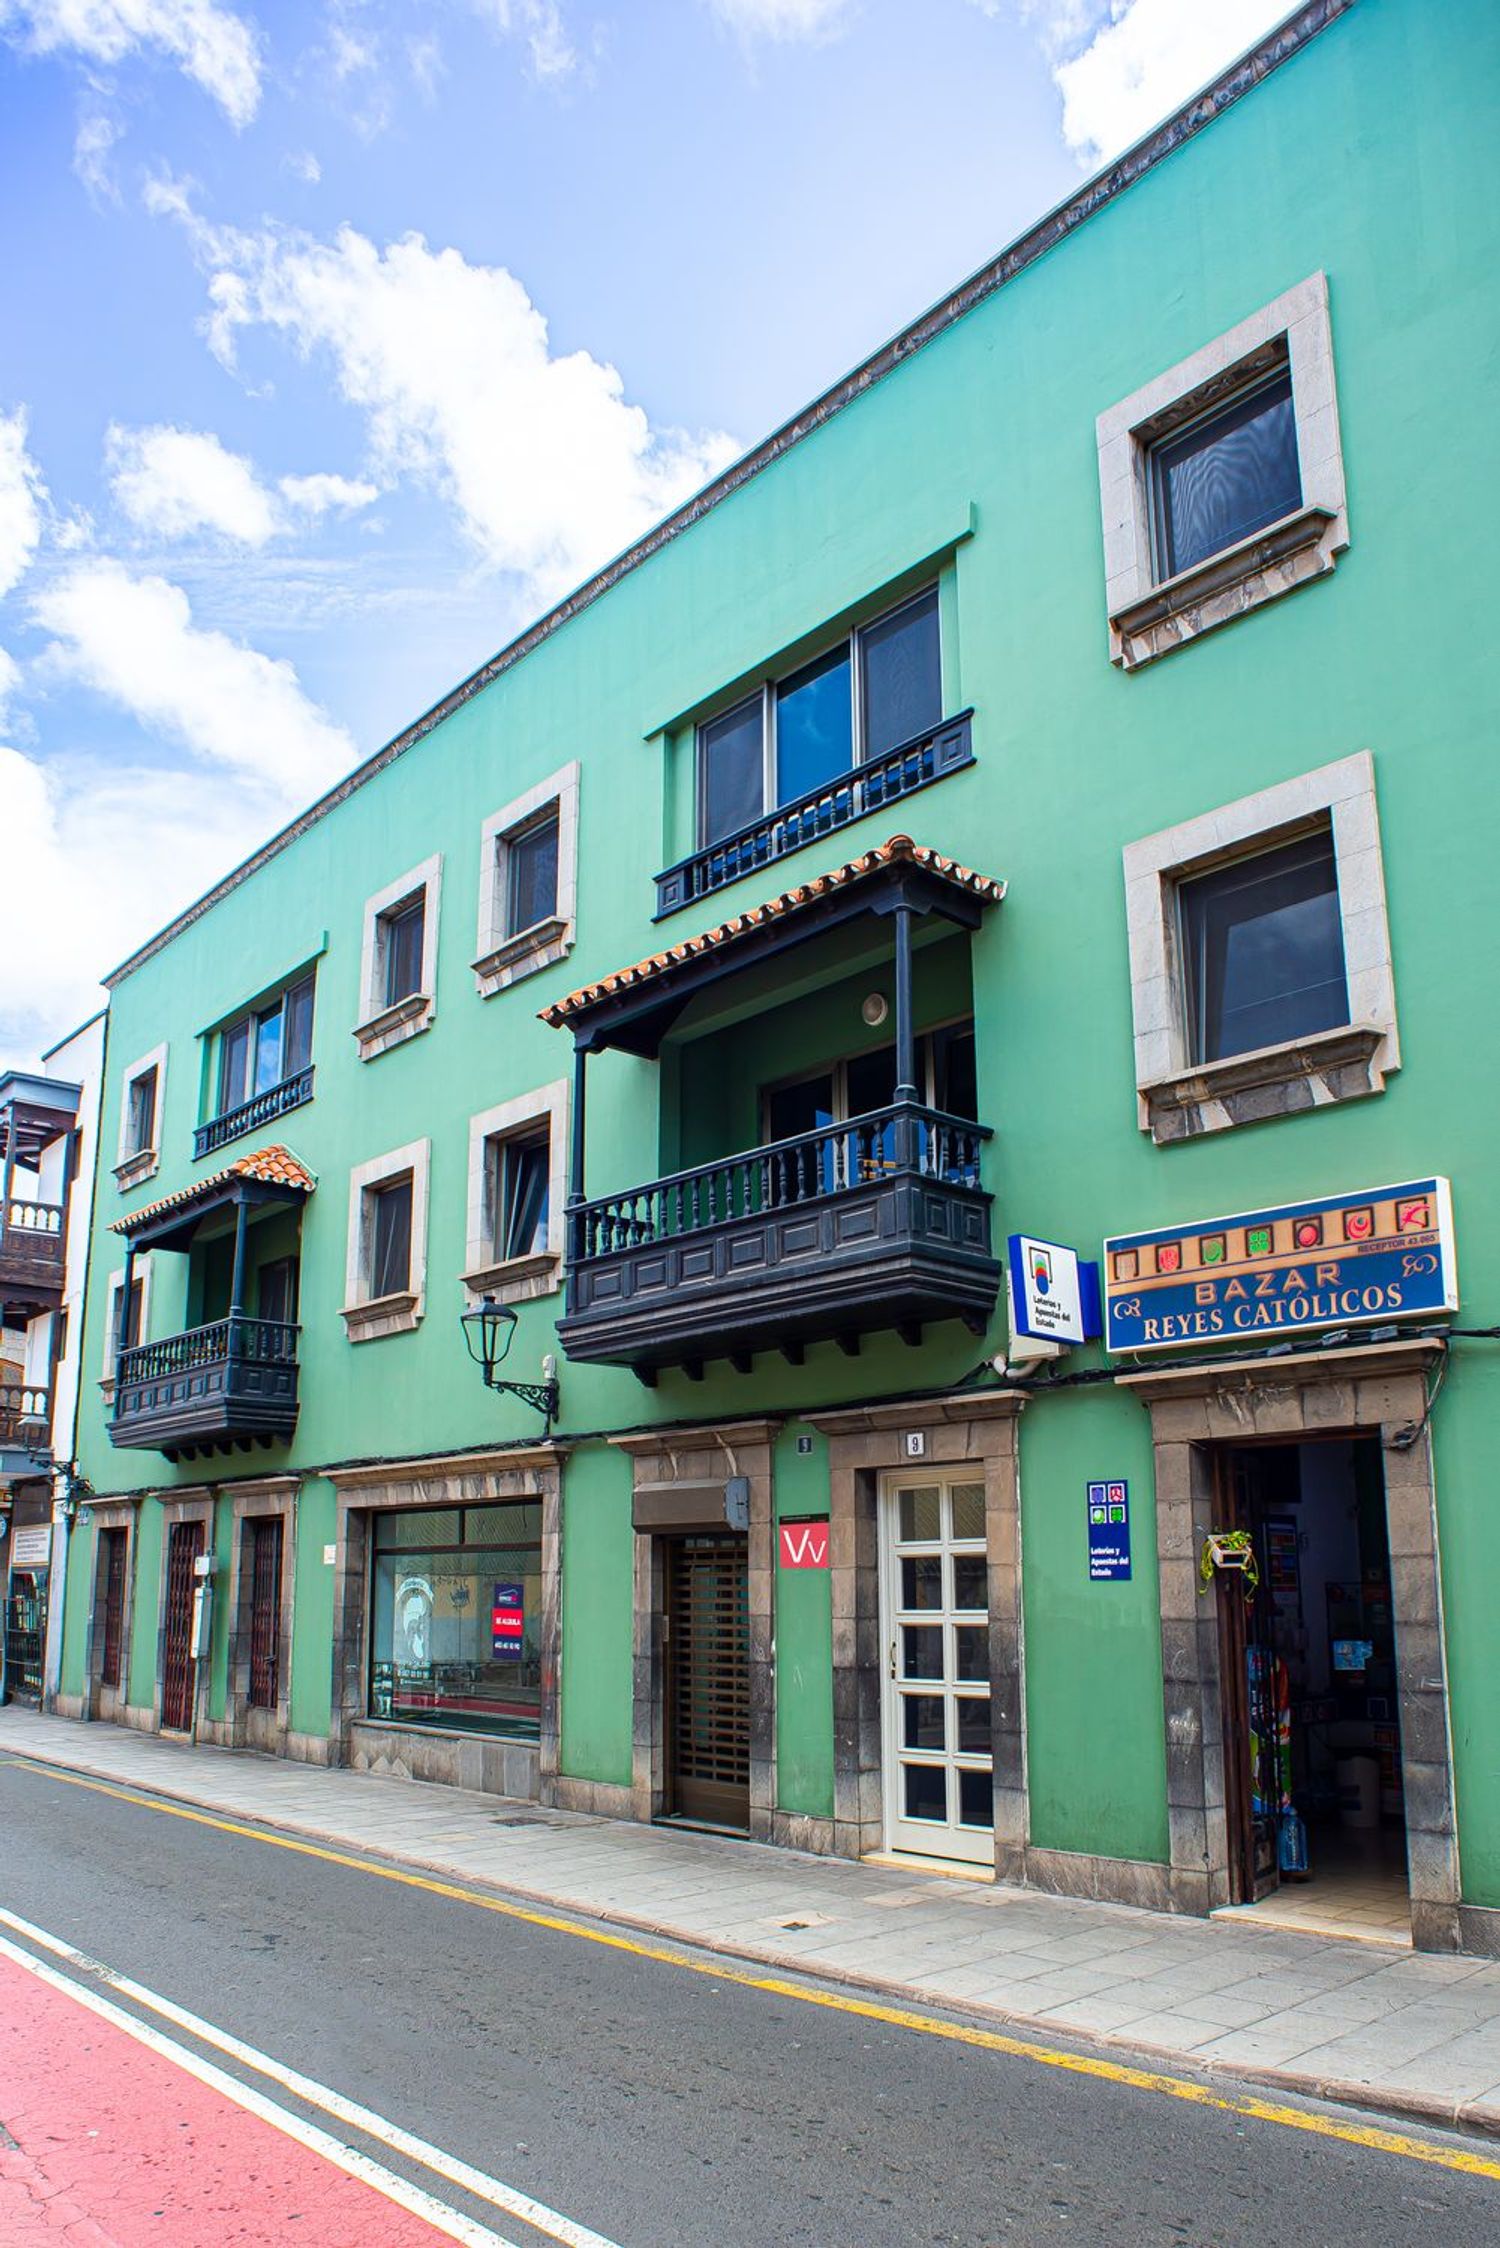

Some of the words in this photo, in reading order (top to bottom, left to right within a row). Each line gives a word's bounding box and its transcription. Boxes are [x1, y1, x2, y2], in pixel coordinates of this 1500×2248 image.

[1357, 1238, 1406, 1253] RECEPTOR
[1195, 1262, 1343, 1306] BAZAR
[1143, 1308, 1224, 1341] REYES
[1233, 1282, 1403, 1328] CATÓLICOS
[912, 1436, 919, 1453] 9
